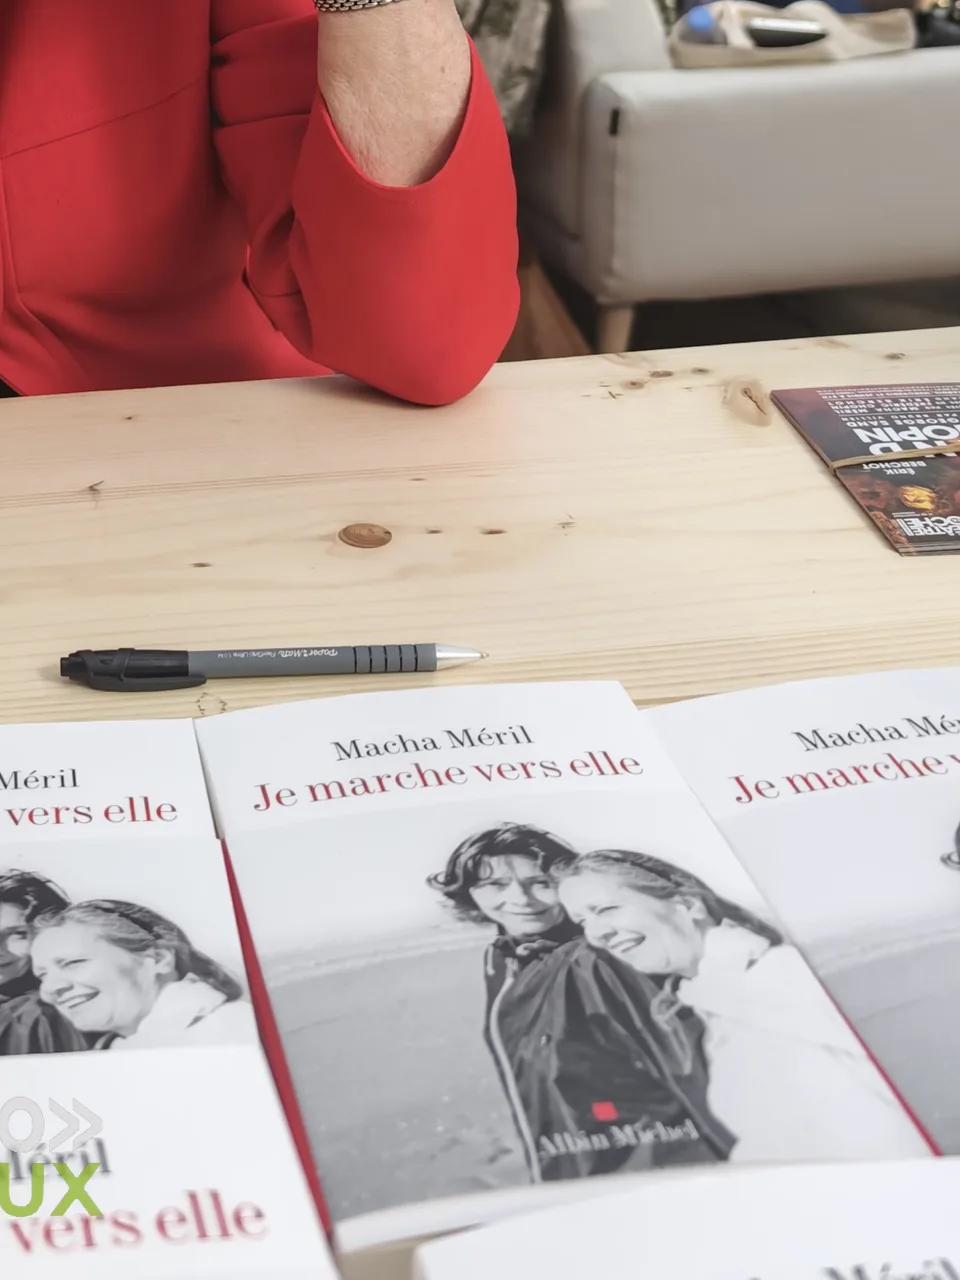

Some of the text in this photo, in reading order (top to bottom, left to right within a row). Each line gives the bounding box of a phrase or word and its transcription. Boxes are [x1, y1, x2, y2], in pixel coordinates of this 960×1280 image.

[853, 424, 960, 443] OPIN
[862, 461, 927, 469] BERCHOT
[331, 725, 535, 762] Macha Méril
[791, 715, 960, 752] Macha Mé
[252, 749, 644, 813] Je marche vers elle
[734, 752, 949, 805] Je marche
[7, 799, 94, 825] vers
[103, 796, 179, 822] elle
[538, 1118, 700, 1157] Albin Michel
[7, 1207, 141, 1254] vers
[153, 1188, 267, 1242] elle
